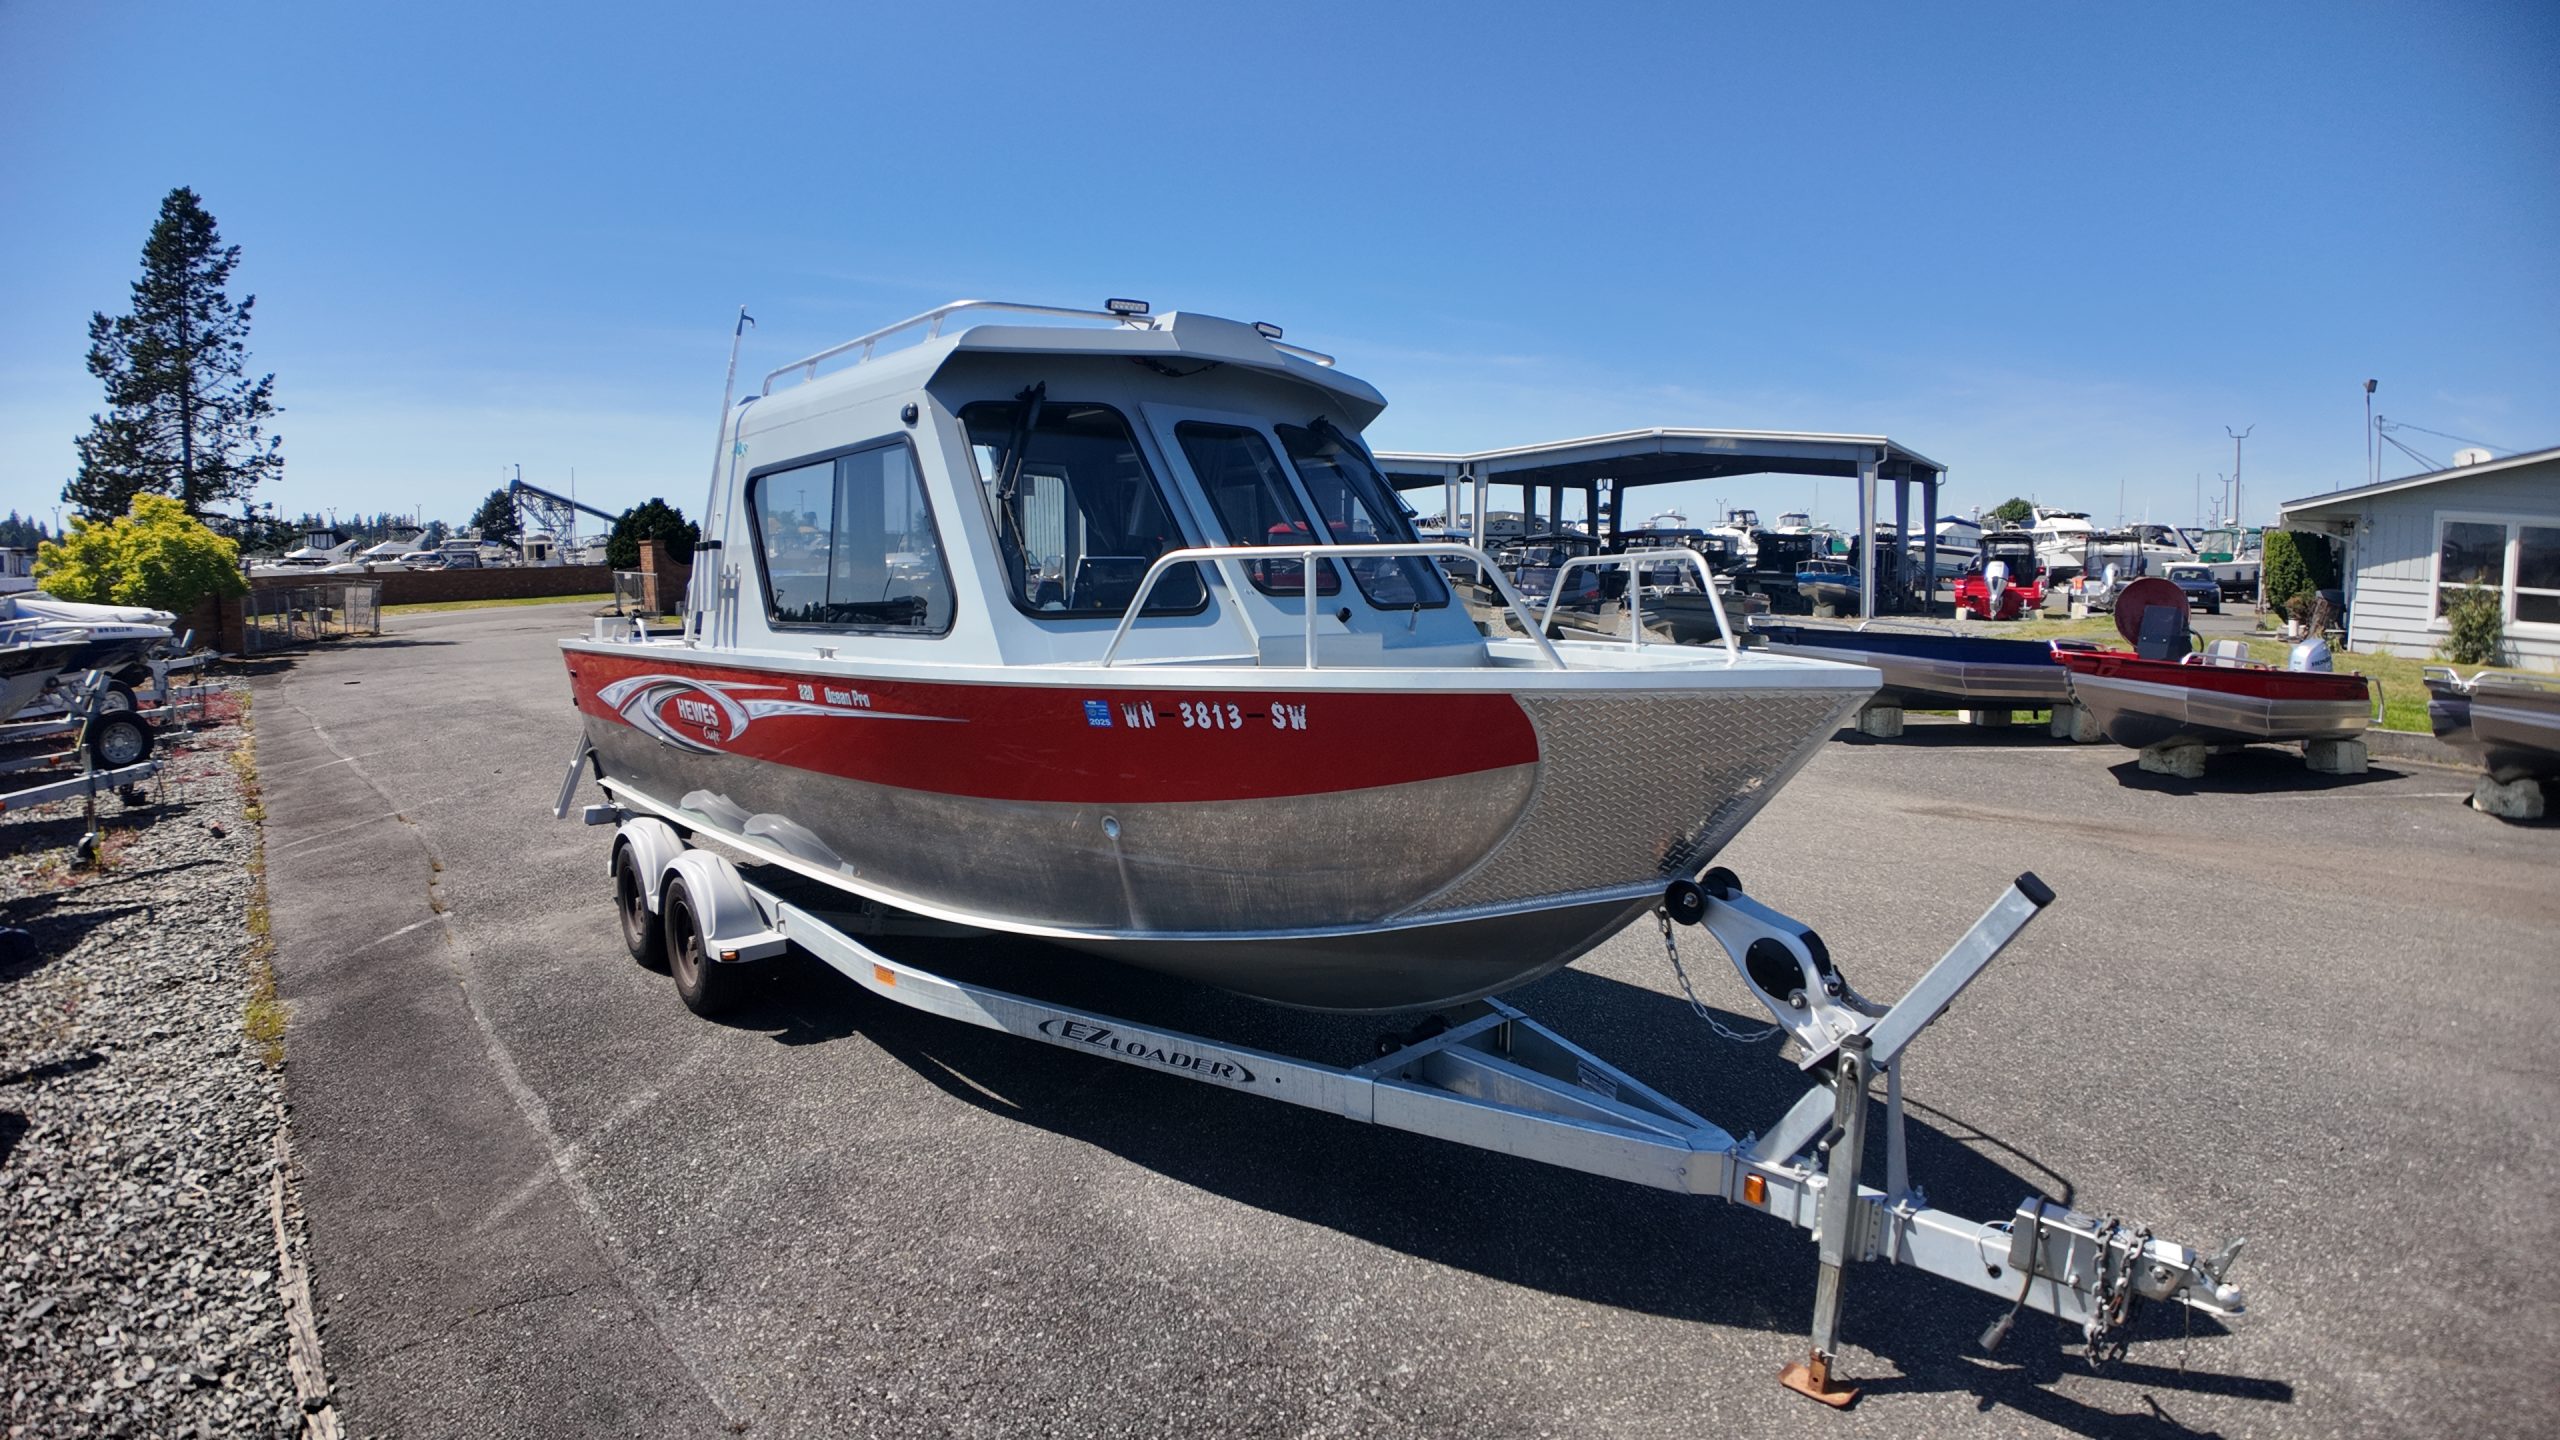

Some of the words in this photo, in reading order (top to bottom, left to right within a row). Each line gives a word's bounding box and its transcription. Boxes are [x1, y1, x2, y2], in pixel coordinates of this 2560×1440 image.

[824, 687, 852, 706] Ocean
[850, 689, 871, 707] Pro
[676, 698, 719, 727] HEWES
[1089, 718, 1112, 727] 2025
[1120, 701, 1156, 729] WN
[1179, 701, 1243, 730] 3813
[1271, 701, 1307, 730] SW
